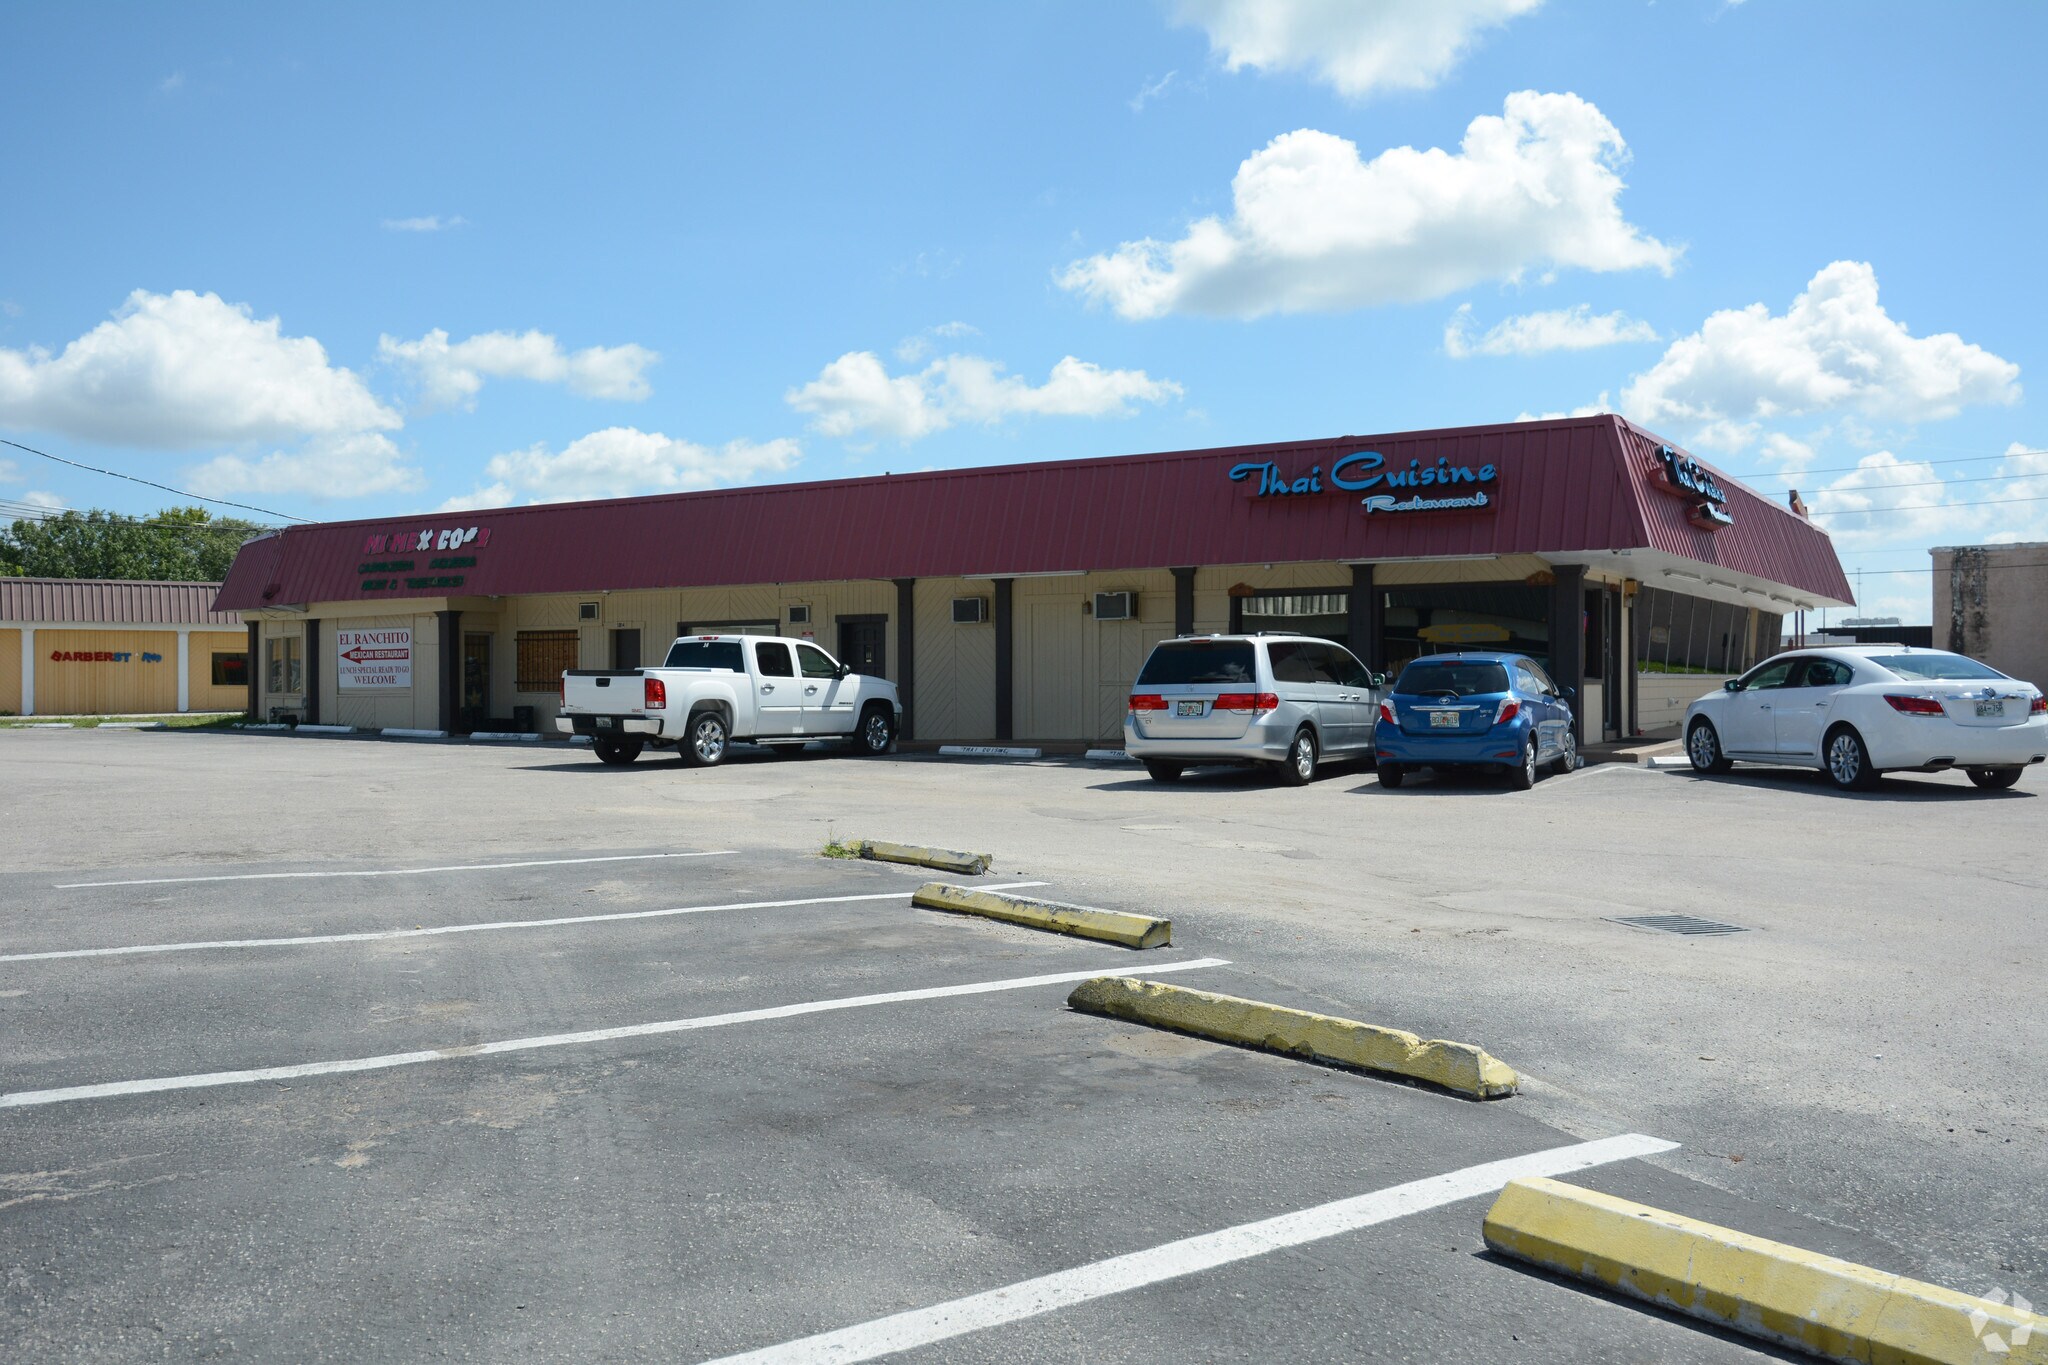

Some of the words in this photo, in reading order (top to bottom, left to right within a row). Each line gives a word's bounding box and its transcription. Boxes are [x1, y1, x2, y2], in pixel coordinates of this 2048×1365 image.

[1229, 460, 1325, 496] Thai
[1331, 451, 1498, 492] Cuisine
[1361, 491, 1489, 514] Restaurant
[339, 633, 352, 645] EL
[354, 631, 409, 645] RANCHITO
[349, 651, 374, 660] MEXICAN
[374, 650, 409, 659] RESTAURANT
[340, 666, 357, 675] LUNCH
[357, 666, 378, 674] SPECIAL
[378, 666, 394, 674] READY
[394, 665, 402, 674] TO
[401, 665, 410, 674] GO
[354, 675, 397, 685] WELCOME
